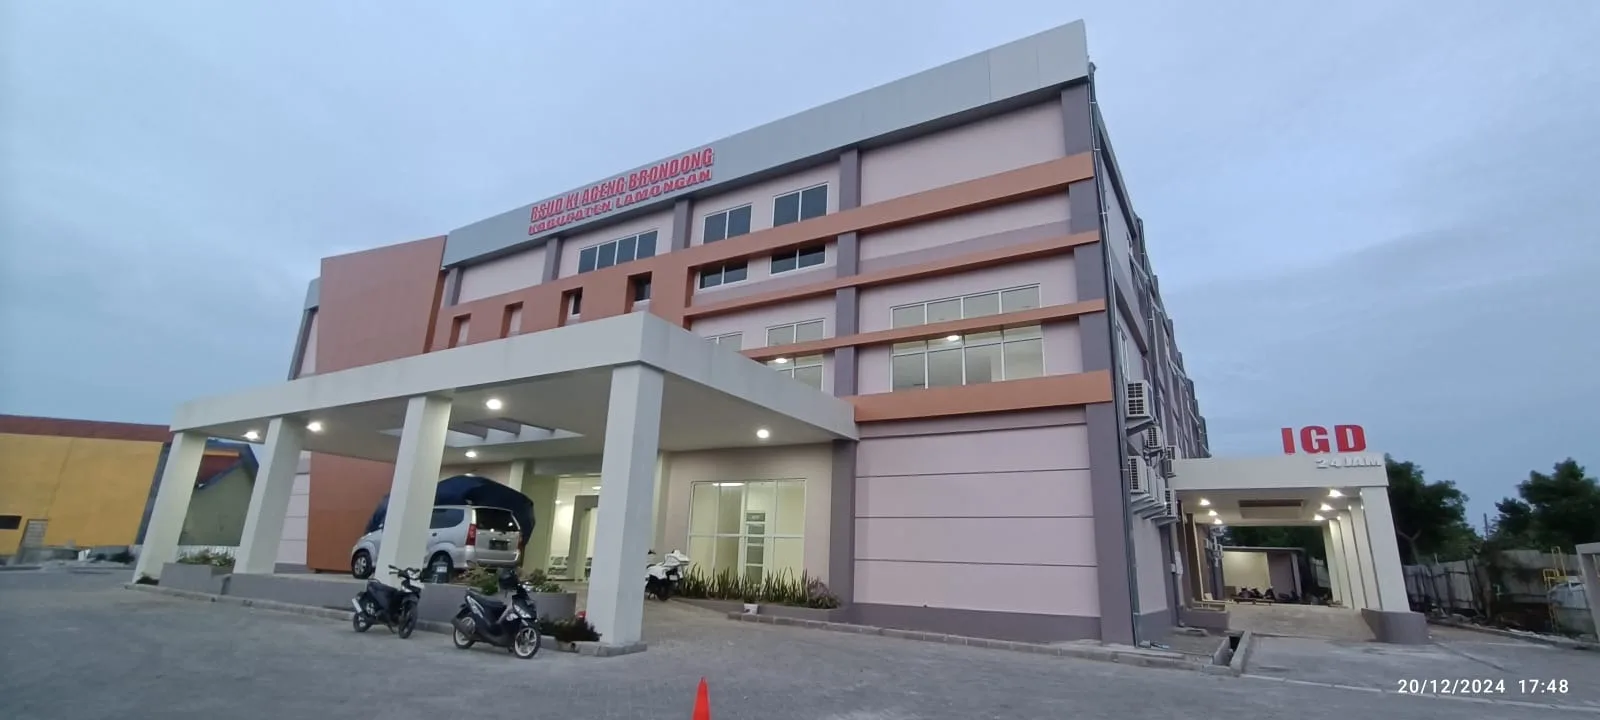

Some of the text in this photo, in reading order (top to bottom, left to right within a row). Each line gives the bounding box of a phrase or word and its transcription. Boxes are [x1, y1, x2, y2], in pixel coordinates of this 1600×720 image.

[528, 169, 712, 235] KABUPATEN LAMONGAN
[531, 147, 714, 223] RSUD KI AGENG BRONDONG
[1281, 424, 1367, 455] IGD
[1315, 456, 1382, 469] 24 JAM
